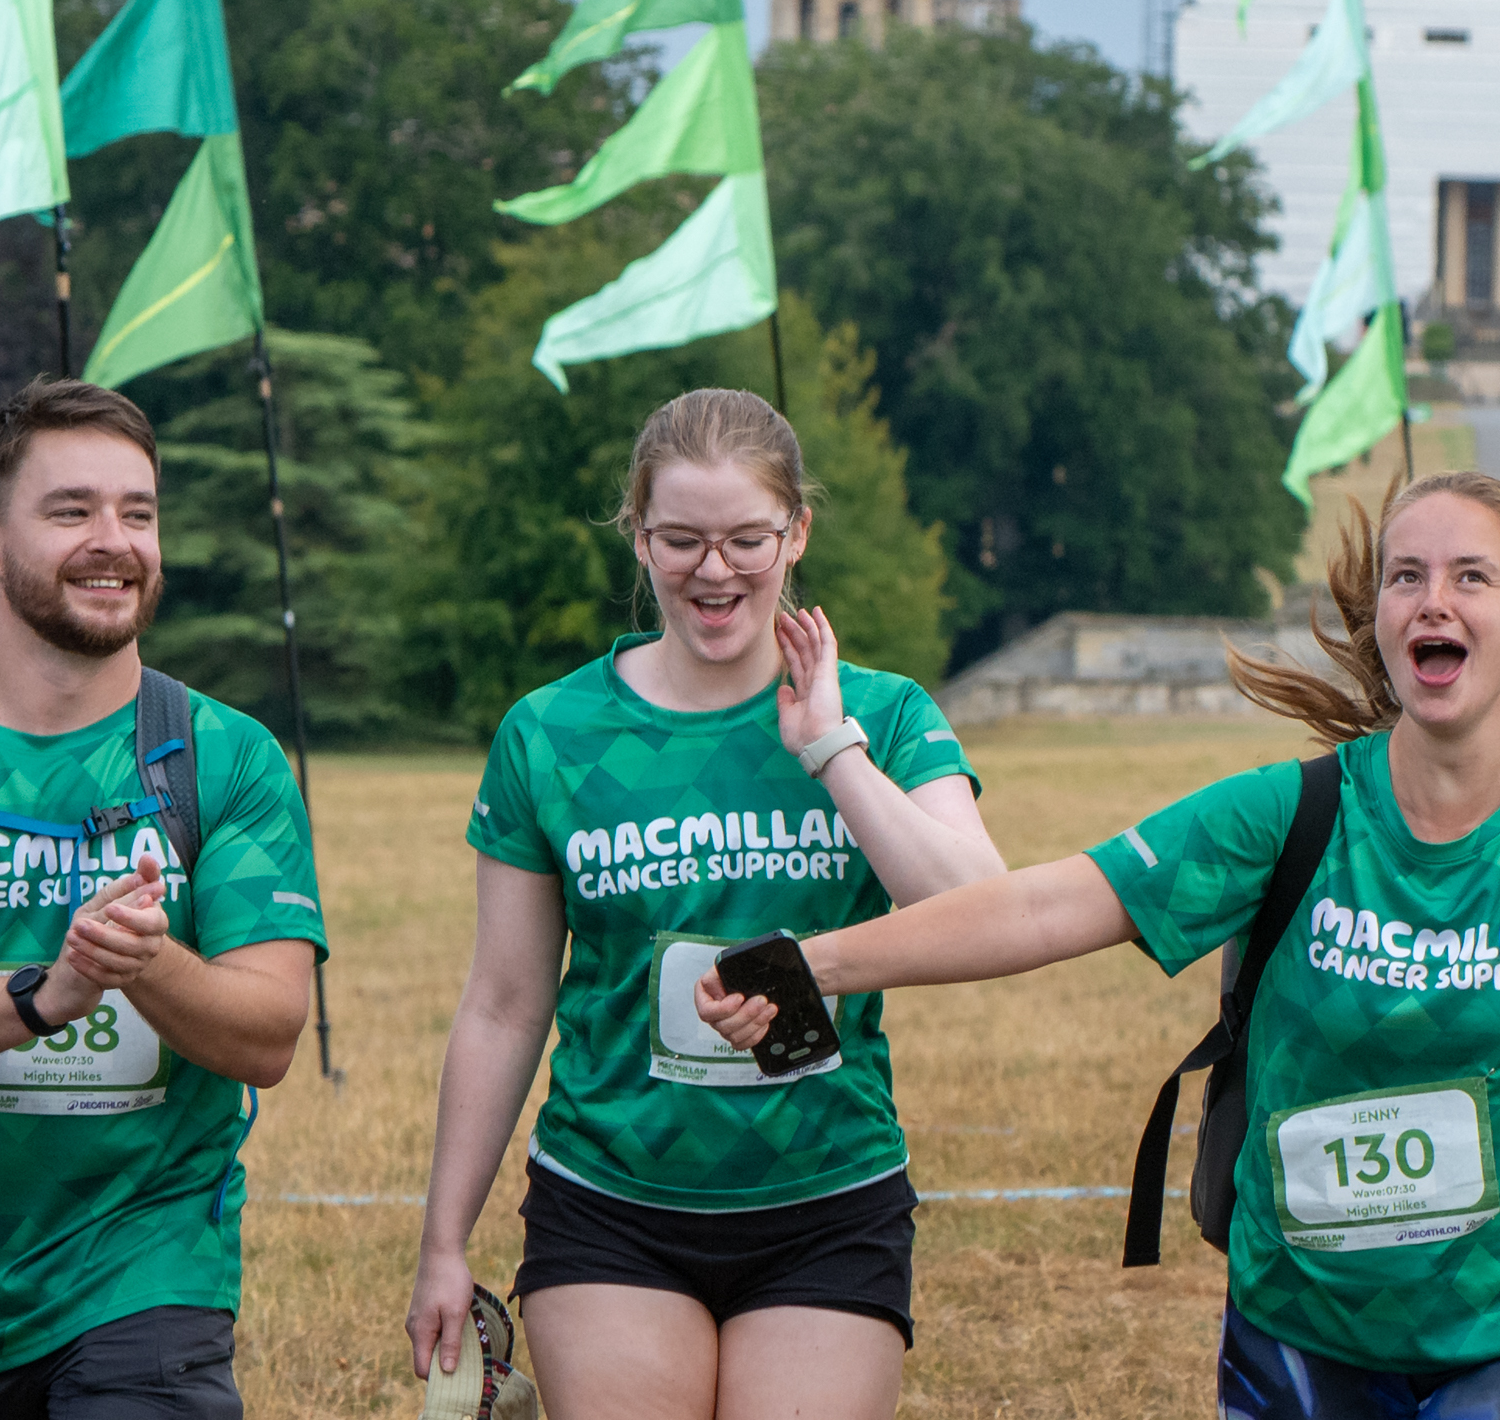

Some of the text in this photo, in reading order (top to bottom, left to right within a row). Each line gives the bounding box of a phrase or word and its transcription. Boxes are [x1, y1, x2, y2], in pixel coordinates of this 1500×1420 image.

[566, 809, 858, 873] MACMILLAN
[577, 851, 849, 899] CANCER SUPPORT
[1308, 941, 1428, 991] CANCER
[32, 1055, 94, 1065] Wave:07:30
[24, 1071, 102, 1083] Mighty Hikes
[80, 1101, 129, 1110] DECATHLON
[1352, 1107, 1400, 1124] JENNY
[1323, 1129, 1435, 1187] 130
[1353, 1184, 1416, 1198] Wave:07:30
[1347, 1200, 1426, 1218] Mighty Hikes
[1408, 1226, 1460, 1239] DECATHLON
